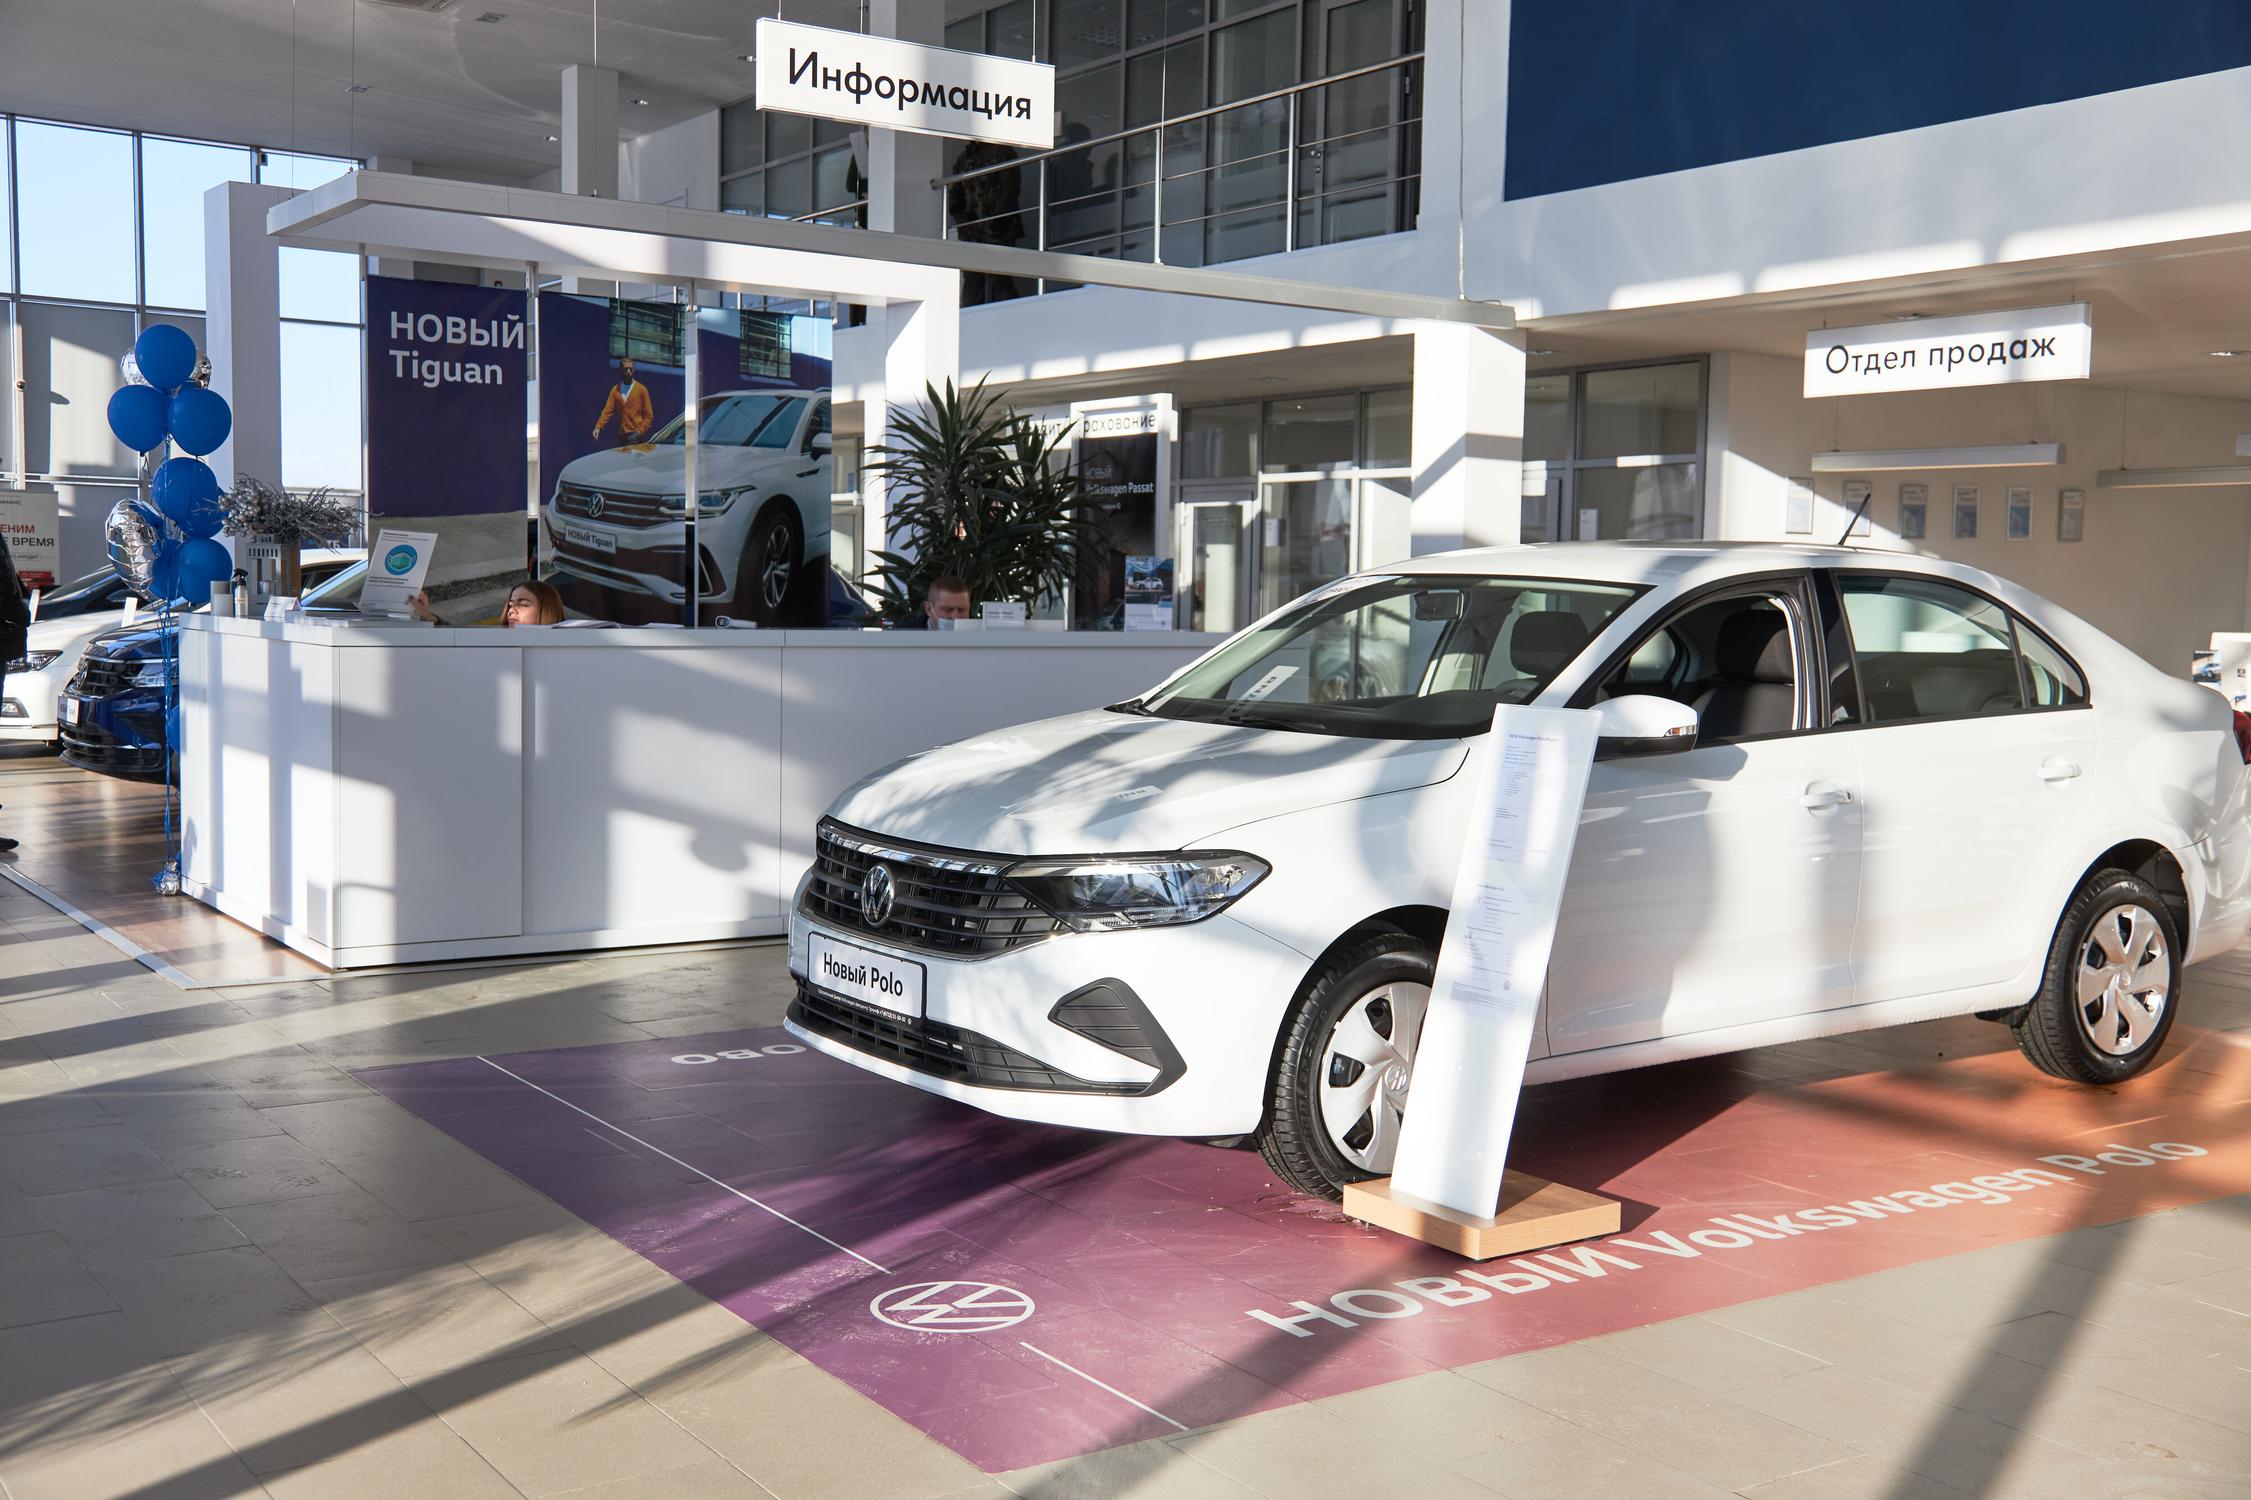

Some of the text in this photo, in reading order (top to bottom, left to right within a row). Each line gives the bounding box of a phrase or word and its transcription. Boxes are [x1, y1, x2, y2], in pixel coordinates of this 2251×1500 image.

[789, 47, 1032, 121] Информация
[390, 311, 524, 349] НОВЫЙ
[389, 349, 503, 388] Tiguan
[1825, 336, 2056, 376] Отдел продаж
[1082, 414, 1156, 433] рахование
[1128, 481, 1154, 494] Passat
[0, 523, 36, 535] ЕНИМ
[12, 536, 55, 548] ВРЕМЯ
[591, 534, 613, 548] Tiguan
[823, 951, 903, 997] Новый Polo
[1607, 1165, 2075, 1259] Volkswagen
[2035, 1137, 2209, 1176] Polo
